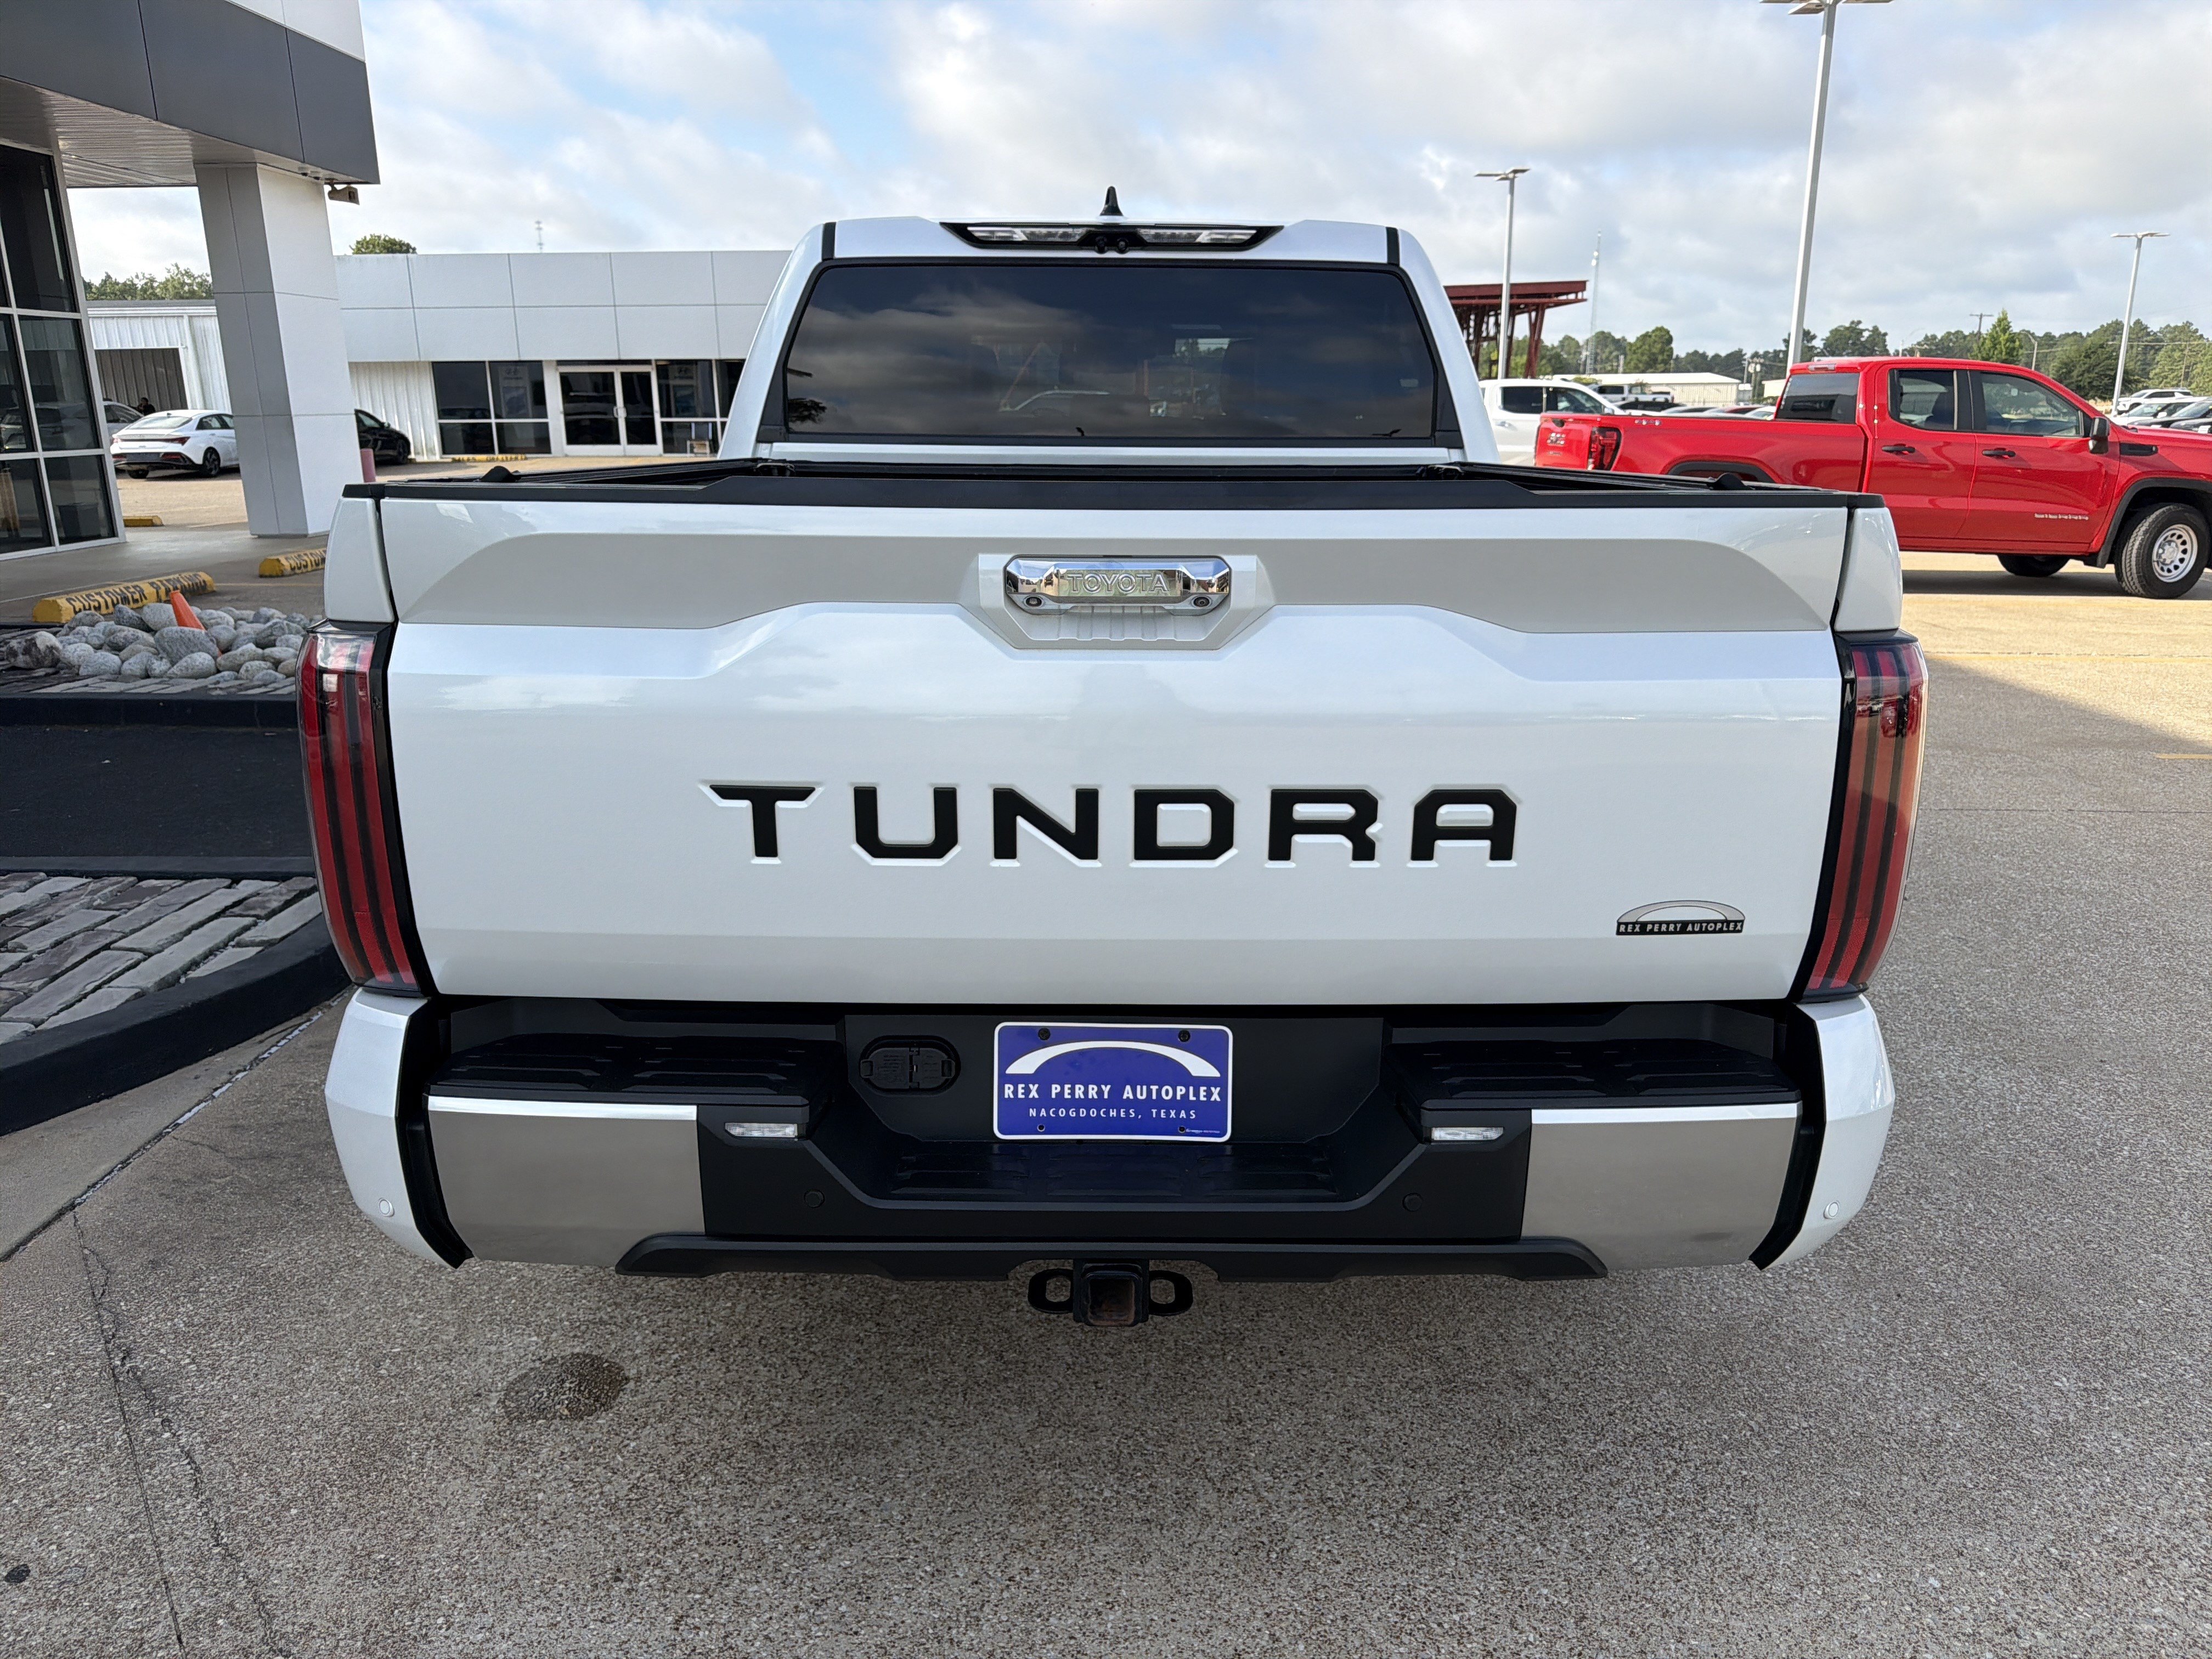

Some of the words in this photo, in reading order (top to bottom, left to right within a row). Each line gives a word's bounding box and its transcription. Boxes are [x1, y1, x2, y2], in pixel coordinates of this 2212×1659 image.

[1067, 573, 1169, 594] TOYOTA
[65, 585, 148, 614] CUSTOMER
[148, 573, 207, 602] PARKING
[699, 783, 1520, 867] TUNDRA
[1619, 924, 1641, 933] REX
[1646, 924, 1681, 933] PERRY
[1686, 922, 1743, 932] AUTOPLEX
[1004, 1084, 1039, 1099] REX
[1051, 1084, 1111, 1100] PERRY
[1123, 1085, 1221, 1102] AUTOPLEX
[1029, 1108, 1142, 1120] NACOGDOCHES,
[1152, 1109, 1197, 1119] TEXAS
